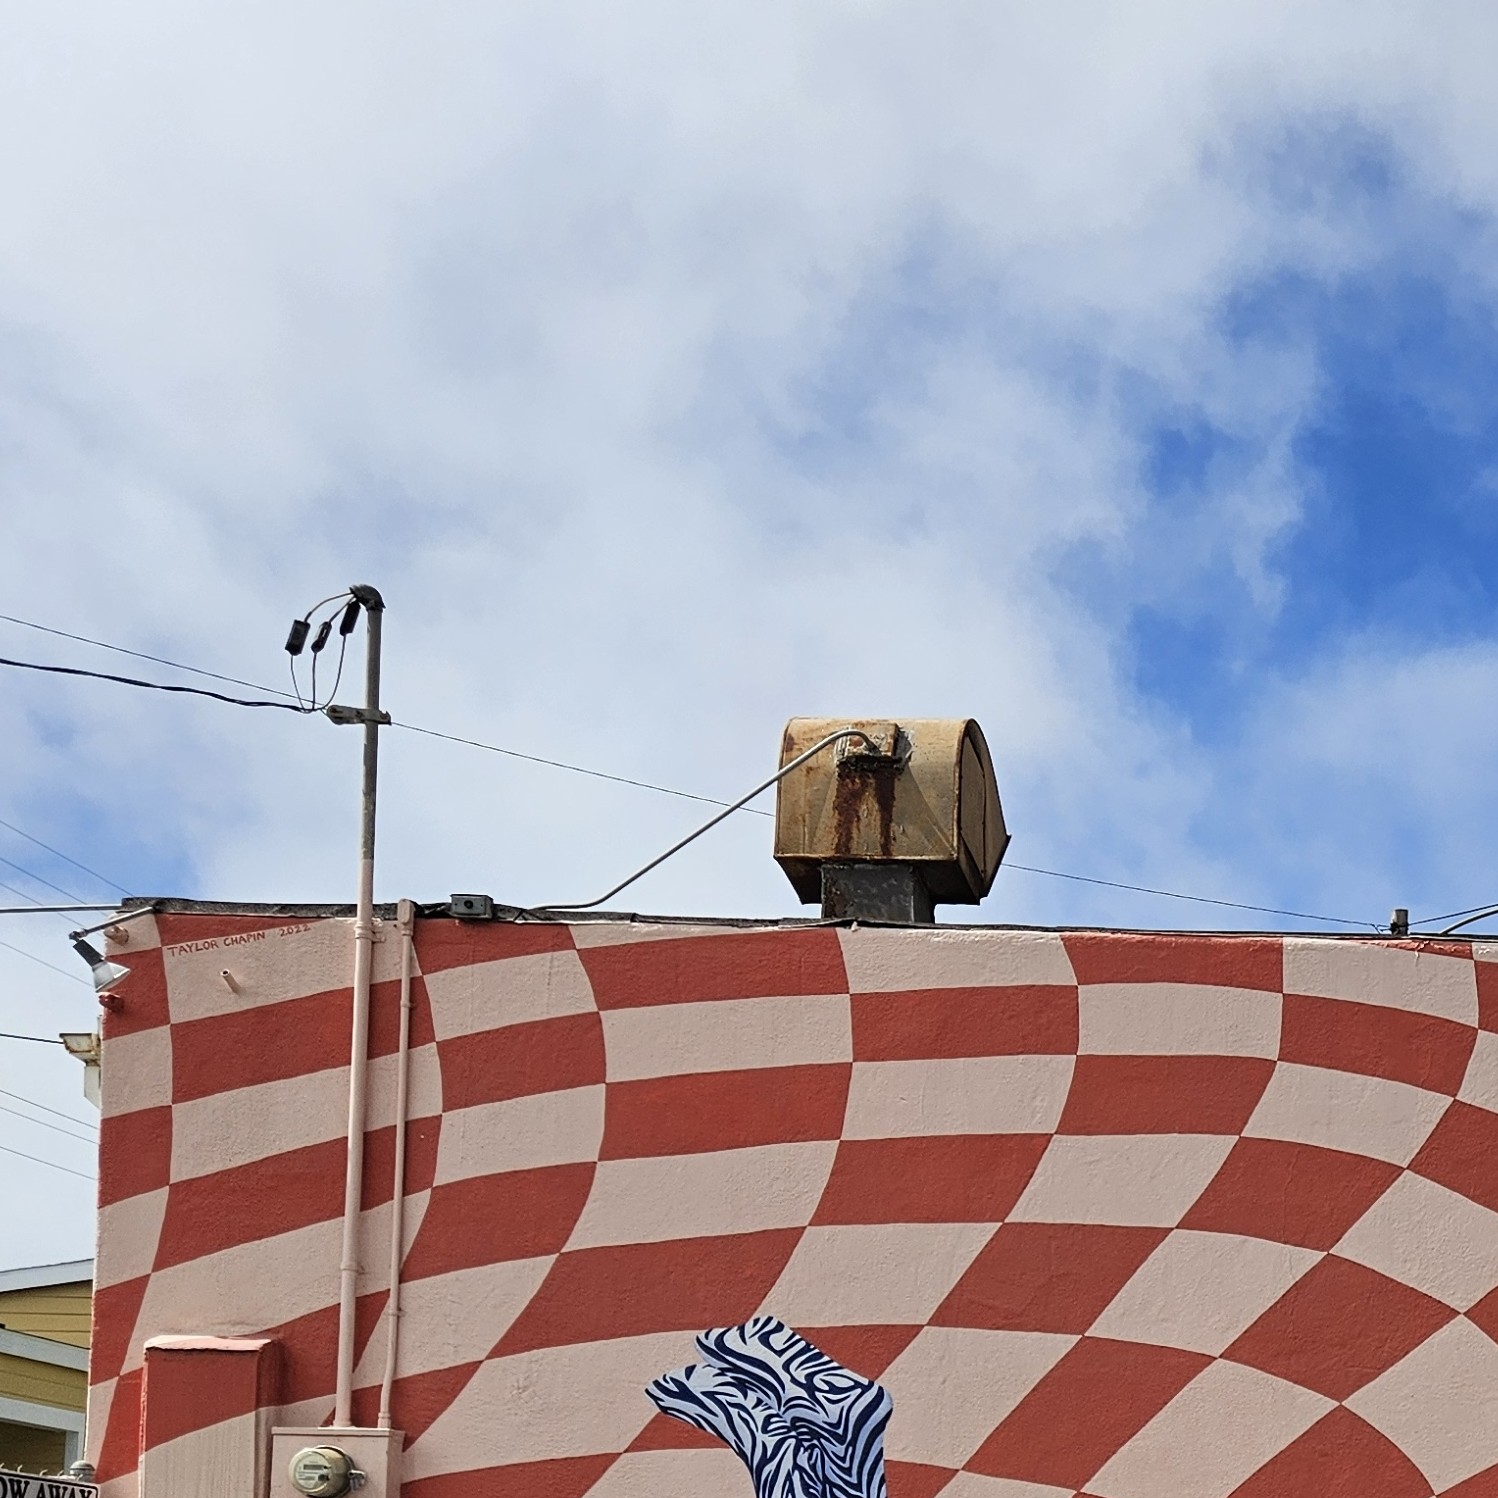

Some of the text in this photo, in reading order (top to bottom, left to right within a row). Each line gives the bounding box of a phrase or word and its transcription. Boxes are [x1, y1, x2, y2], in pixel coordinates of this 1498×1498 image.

[167, 924, 311, 957] TAYLOR CHAPIN 2022
